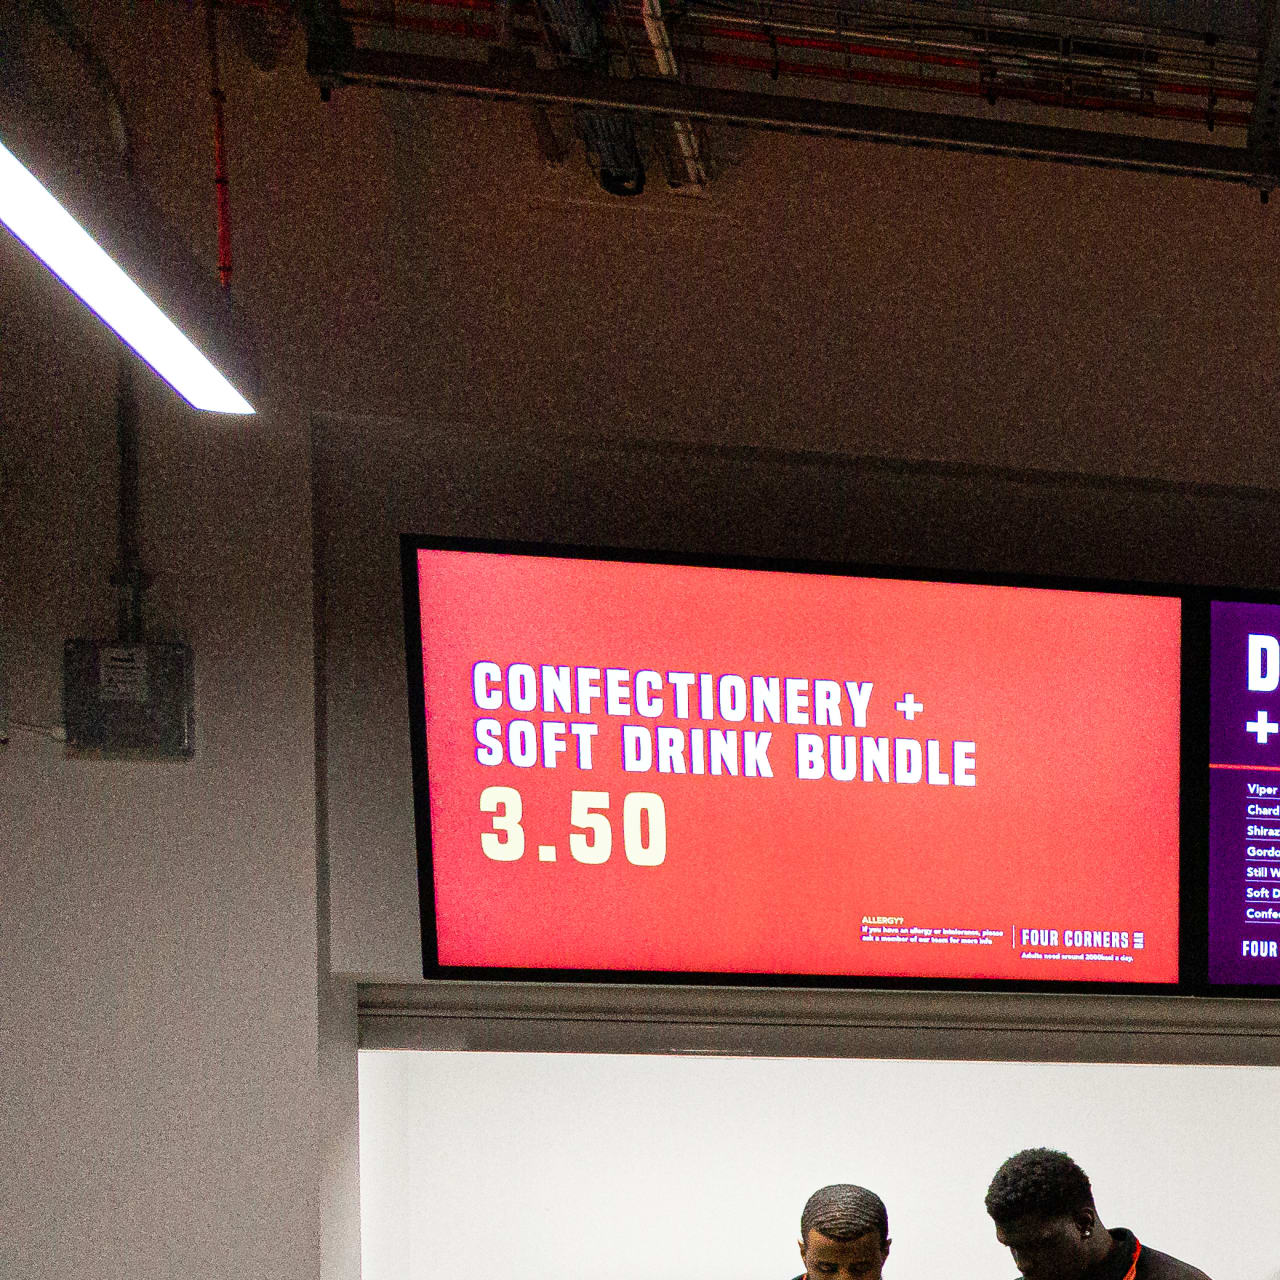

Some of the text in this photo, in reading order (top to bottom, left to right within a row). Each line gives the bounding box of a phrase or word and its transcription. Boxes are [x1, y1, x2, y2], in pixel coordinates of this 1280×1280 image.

[473, 660, 923, 728] CONFECTIONERY +
[1246, 710, 1279, 743] +
[475, 718, 976, 787] SOFT DRINK BUNDLE
[1248, 784, 1277, 797] Viper
[479, 786, 667, 866] 3.50
[1247, 826, 1280, 837] Shiraz
[1247, 867, 1267, 878] Still
[1247, 888, 1270, 899] Soft
[862, 916, 903, 924] ALLERGY?
[1021, 929, 1058, 947] FOUR
[1064, 931, 1129, 948] CORNERS
[1242, 940, 1277, 957] FOUR
